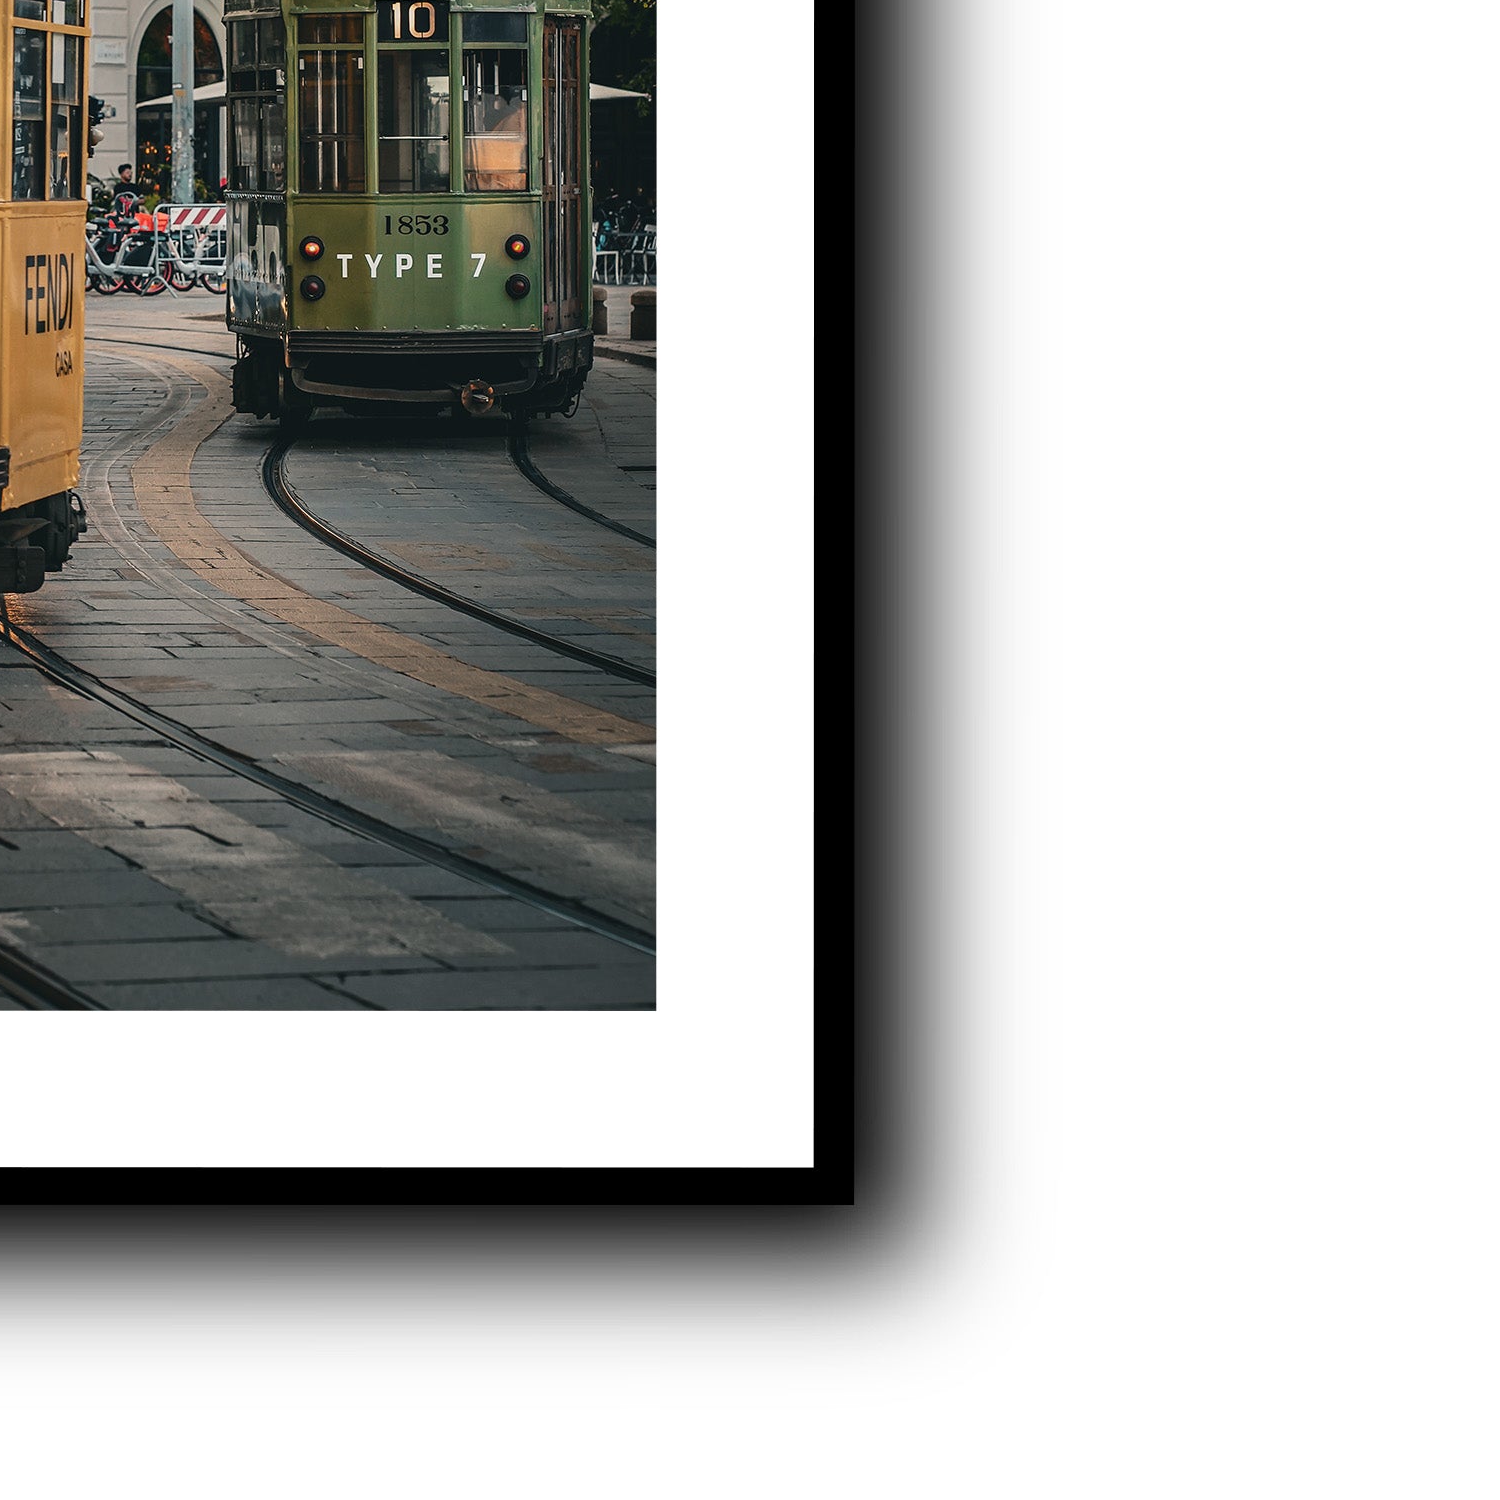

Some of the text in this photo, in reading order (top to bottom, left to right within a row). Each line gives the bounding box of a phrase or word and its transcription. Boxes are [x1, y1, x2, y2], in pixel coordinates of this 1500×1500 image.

[392, 2, 436, 39] 10
[384, 214, 450, 236] 1853
[336, 253, 487, 278] TYPE 7
[25, 252, 74, 335] FENDI
[55, 350, 73, 378] CASA
